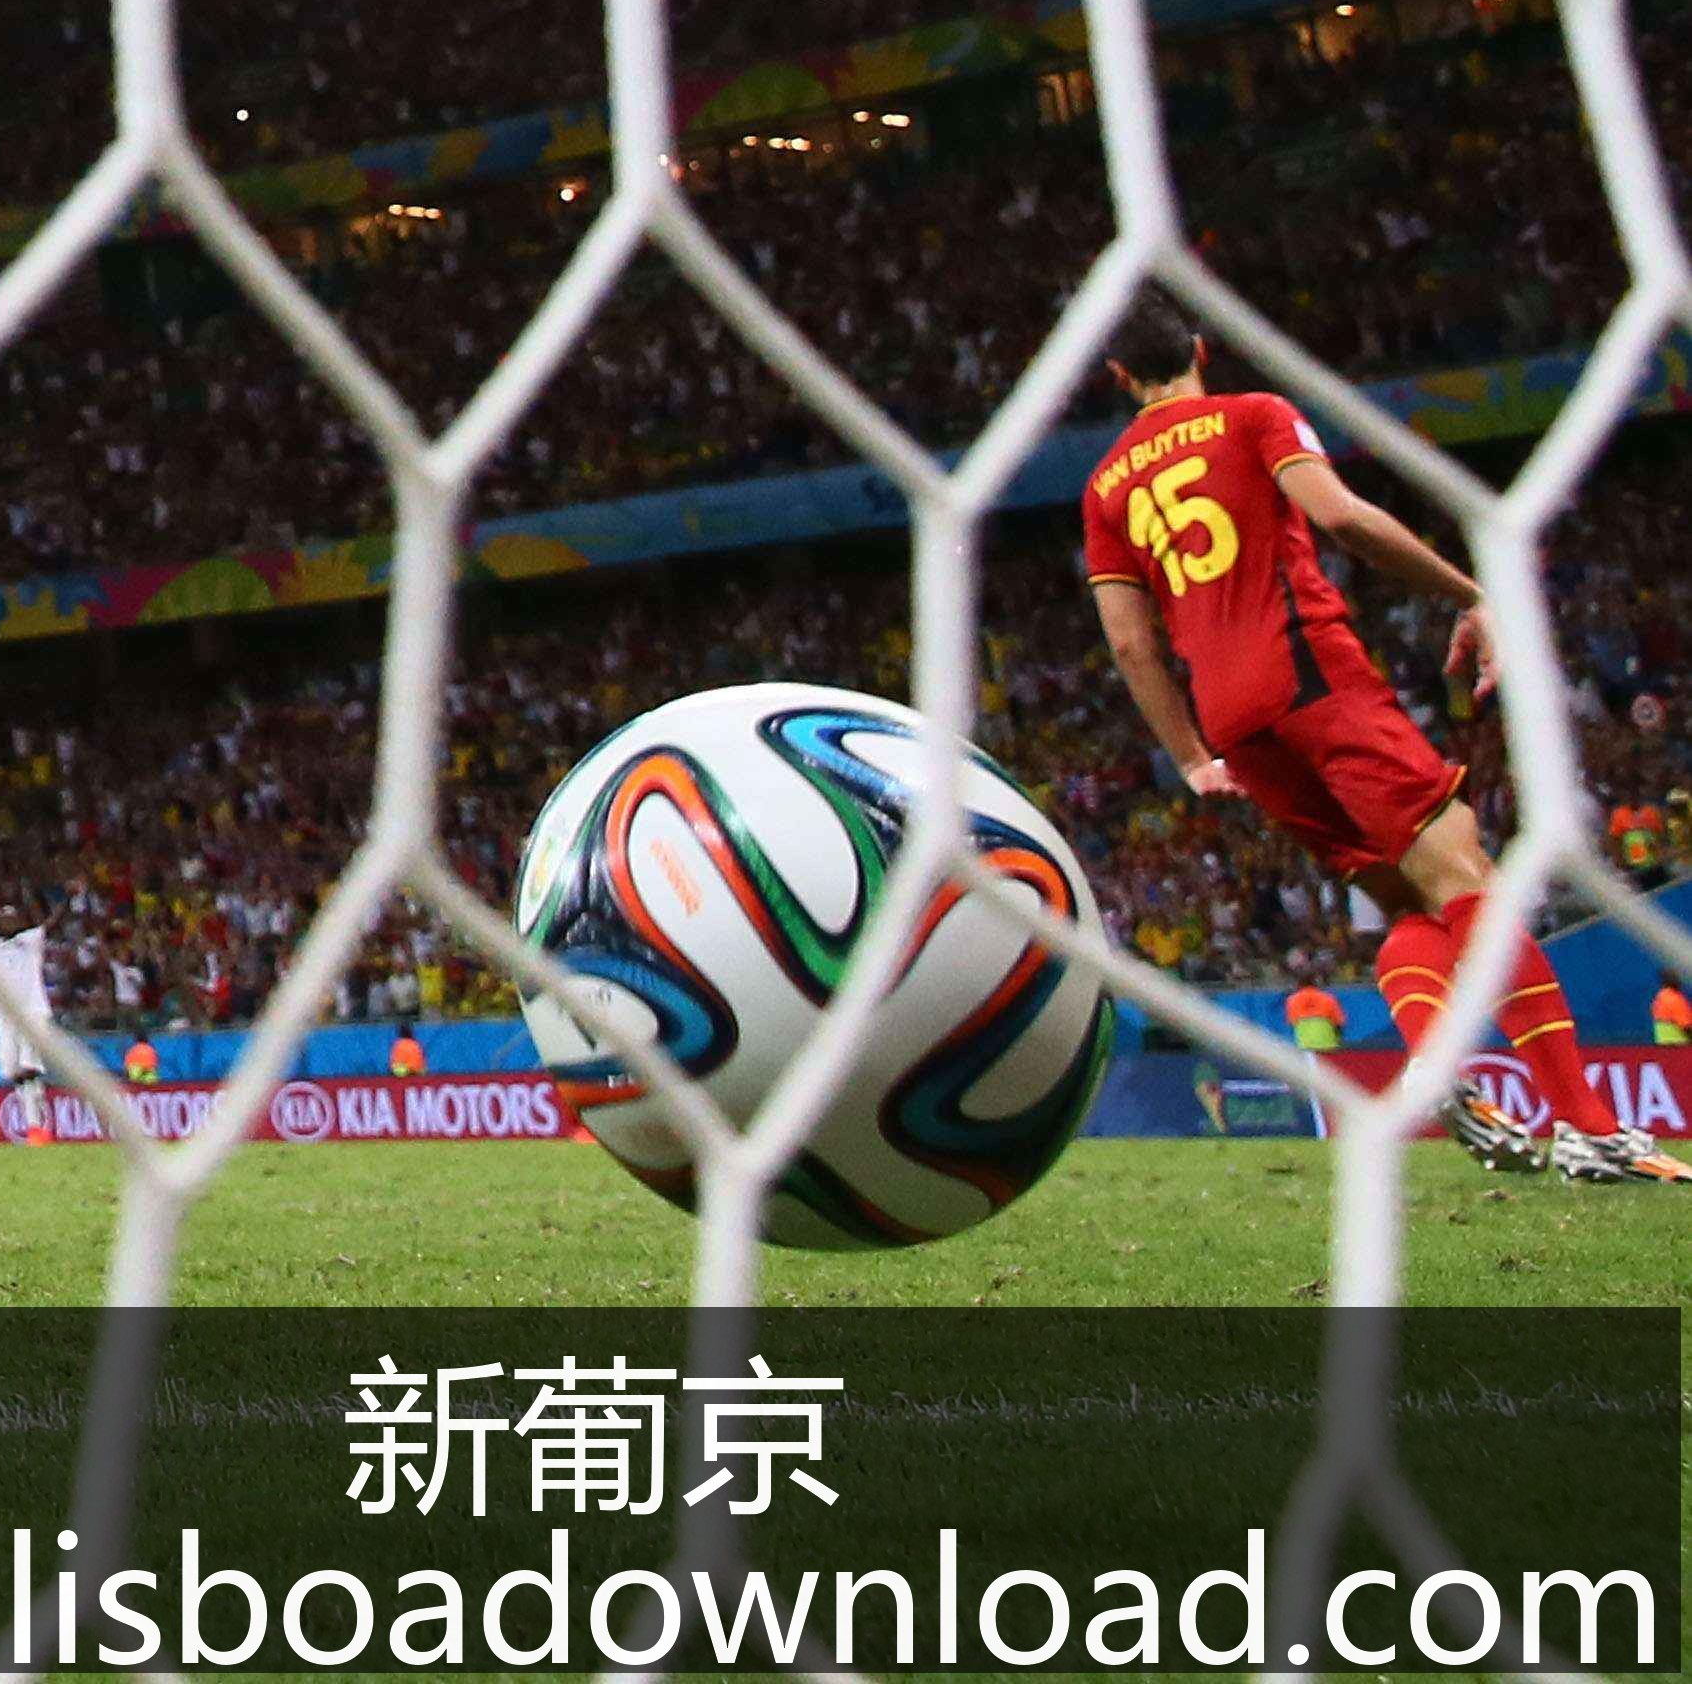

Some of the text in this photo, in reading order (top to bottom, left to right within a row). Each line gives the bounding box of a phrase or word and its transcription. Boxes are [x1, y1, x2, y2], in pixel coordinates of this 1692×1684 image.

[1129, 411, 1226, 473] BUYTEN
[1128, 455, 1239, 597] 15
[336, 1081, 560, 1139] KIA MOTORS
